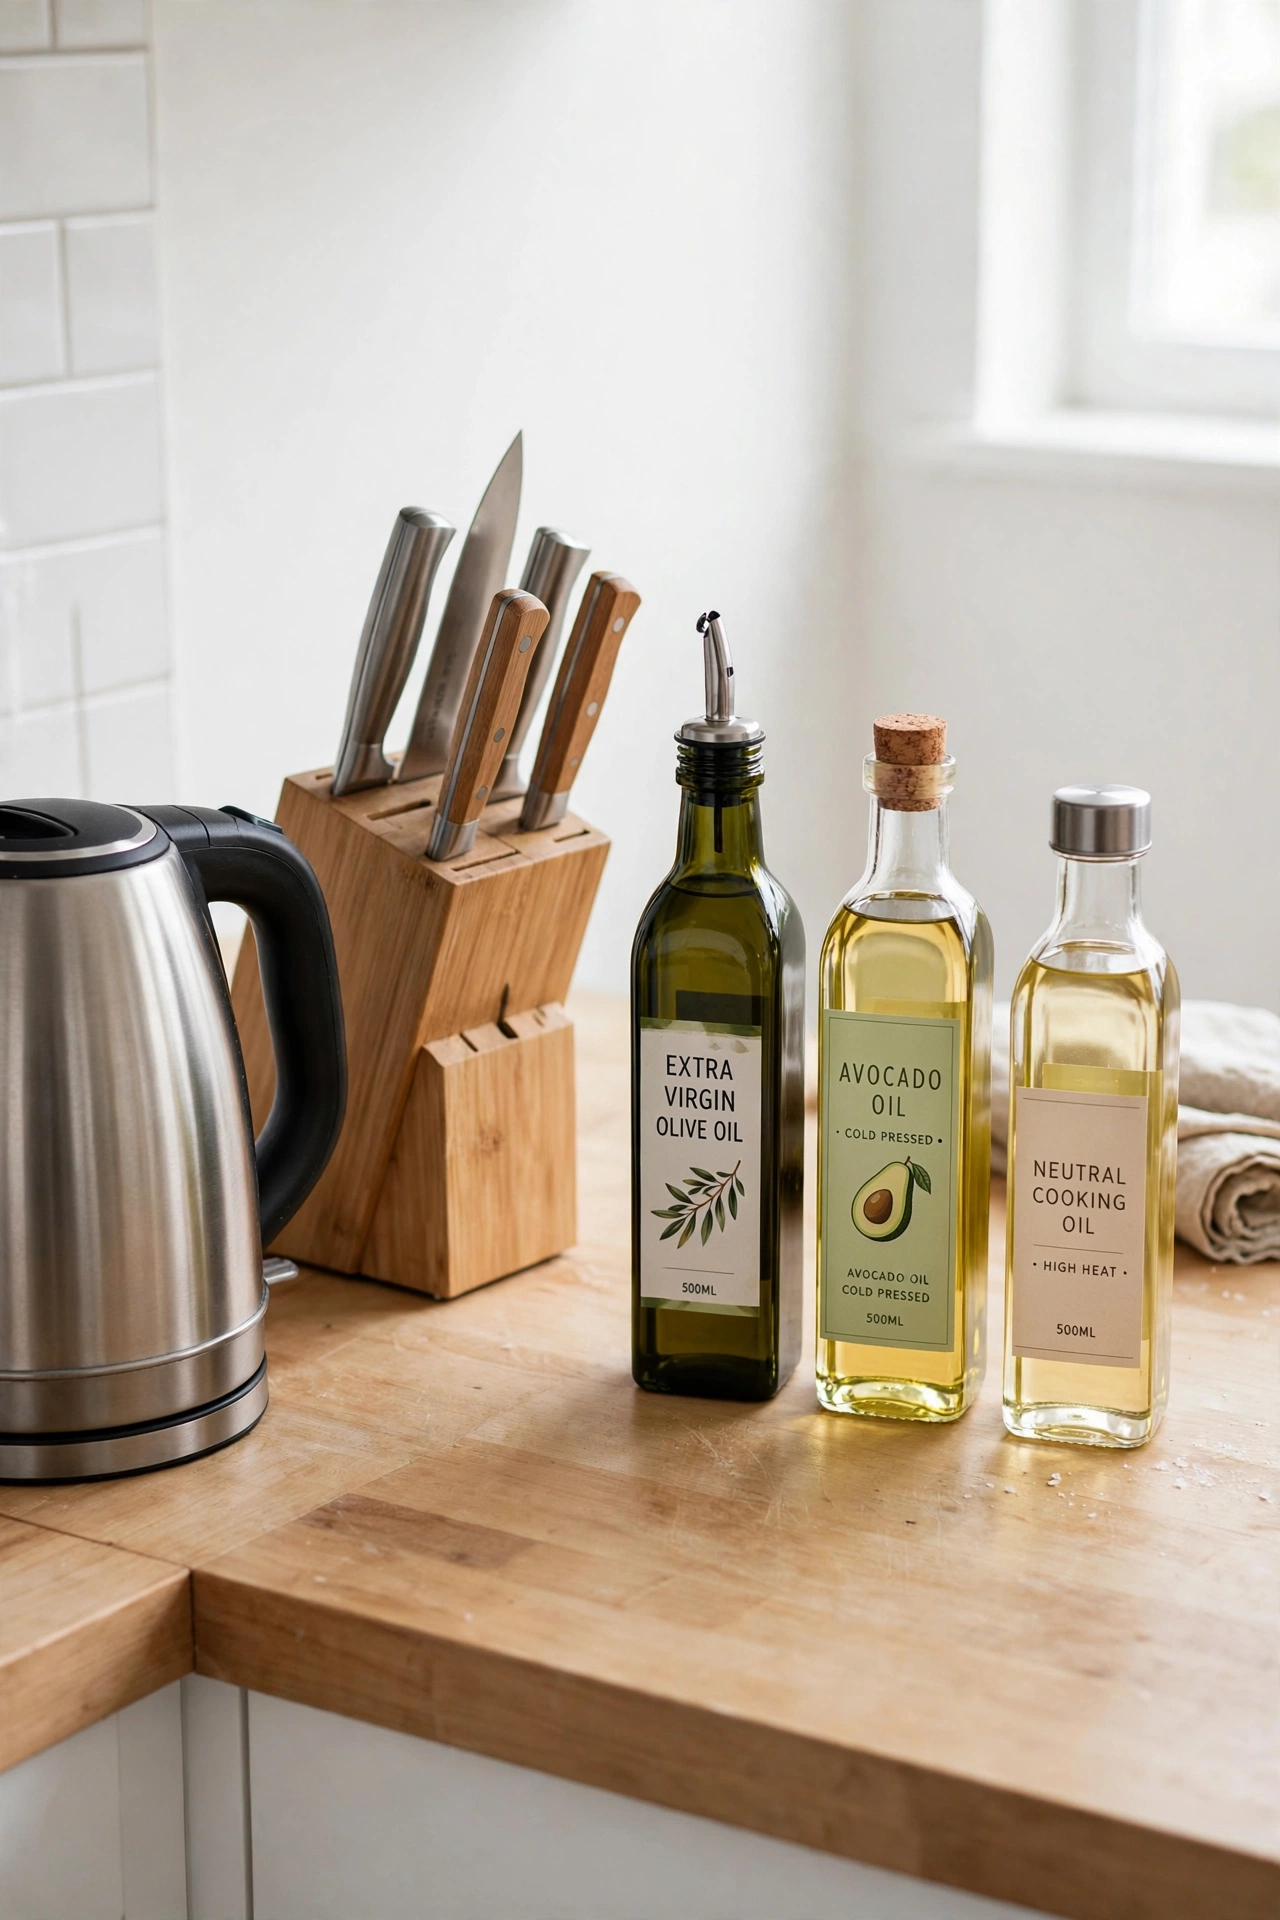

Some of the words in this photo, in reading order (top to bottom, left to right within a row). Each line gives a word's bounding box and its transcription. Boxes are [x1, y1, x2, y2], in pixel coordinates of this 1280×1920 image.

[667, 1054, 733, 1080] EXTRA
[839, 1062, 942, 1090] AVOCADO
[665, 1085, 735, 1112] VIRGIN
[872, 1094, 906, 1117] OIL
[656, 1116, 707, 1140] OLIVE
[713, 1121, 743, 1142] OIL
[845, 1128, 876, 1141] COLD
[881, 1131, 933, 1146] PRESSED
[1033, 1159, 1126, 1185] NEUTRAL
[1032, 1187, 1126, 1211] COOKING
[1062, 1216, 1095, 1235] OIL
[846, 1268, 905, 1283] AVOCADO
[909, 1273, 929, 1286] OIL
[1043, 1260, 1076, 1274] HIGH
[1082, 1264, 1117, 1278] HEAT
[681, 1282, 717, 1296] 500ML
[841, 1284, 873, 1297] COLD
[877, 1288, 930, 1303] PRESSED
[866, 1312, 904, 1327] 500ML
[1056, 1323, 1096, 1339] 500ML
